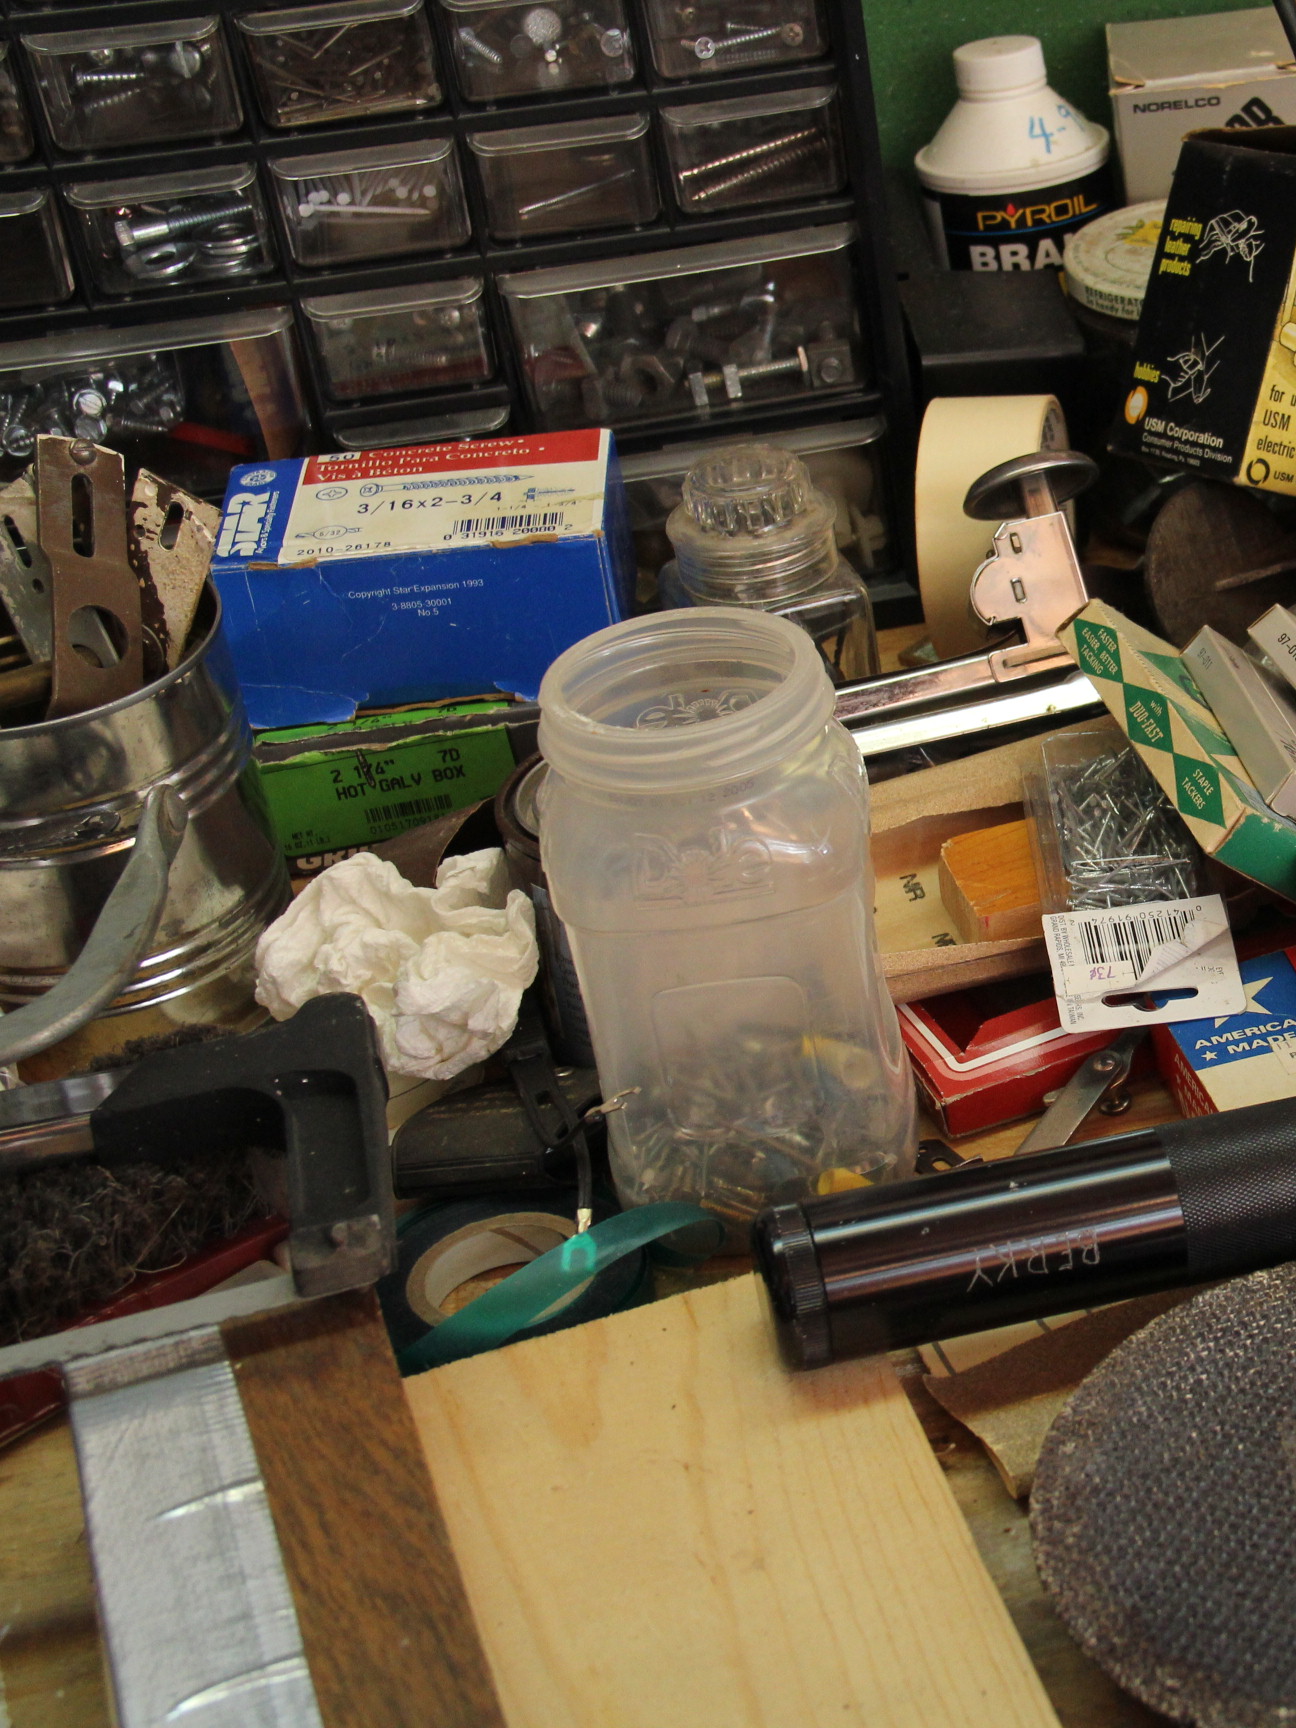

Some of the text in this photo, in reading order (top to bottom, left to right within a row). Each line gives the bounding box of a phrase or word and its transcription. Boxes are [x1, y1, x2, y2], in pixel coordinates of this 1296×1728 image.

[1133, 96, 1221, 114] NORELCO
[977, 194, 1098, 231] PYROIL
[1170, 216, 1203, 240] repairing
[969, 233, 1074, 272] BRA
[1164, 236, 1191, 256] leather
[1159, 256, 1191, 277] products
[1269, 385, 1285, 403] for
[1144, 417, 1224, 448] USM Corporation
[1263, 409, 1291, 431] USM
[318, 446, 530, 473] Tornillo Para Concreto
[368, 439, 514, 458] Concrete Screw
[1142, 433, 1173, 448] Consumer
[1173, 440, 1203, 456] Products
[1204, 448, 1233, 464] Division
[1256, 435, 1296, 460] electric
[317, 471, 346, 481] Vis
[369, 465, 424, 477] Béton
[1274, 470, 1295, 483] USM
[356, 491, 503, 515] 3/16x2-3/4
[348, 578, 484, 599] Copyright Star Expansion 1993
[1081, 627, 1118, 675] EASIER, BETTER
[1097, 628, 1118, 653] FASTER
[1080, 645, 1103, 674] TACKING
[1149, 700, 1162, 717] with
[1129, 700, 1164, 743] DUO-FAST
[330, 747, 462, 784] 2 7D
[335, 764, 467, 801] HOT GALV BOX
[1181, 777, 1206, 811] TACKERS
[1192, 768, 1214, 796] STAPLE
